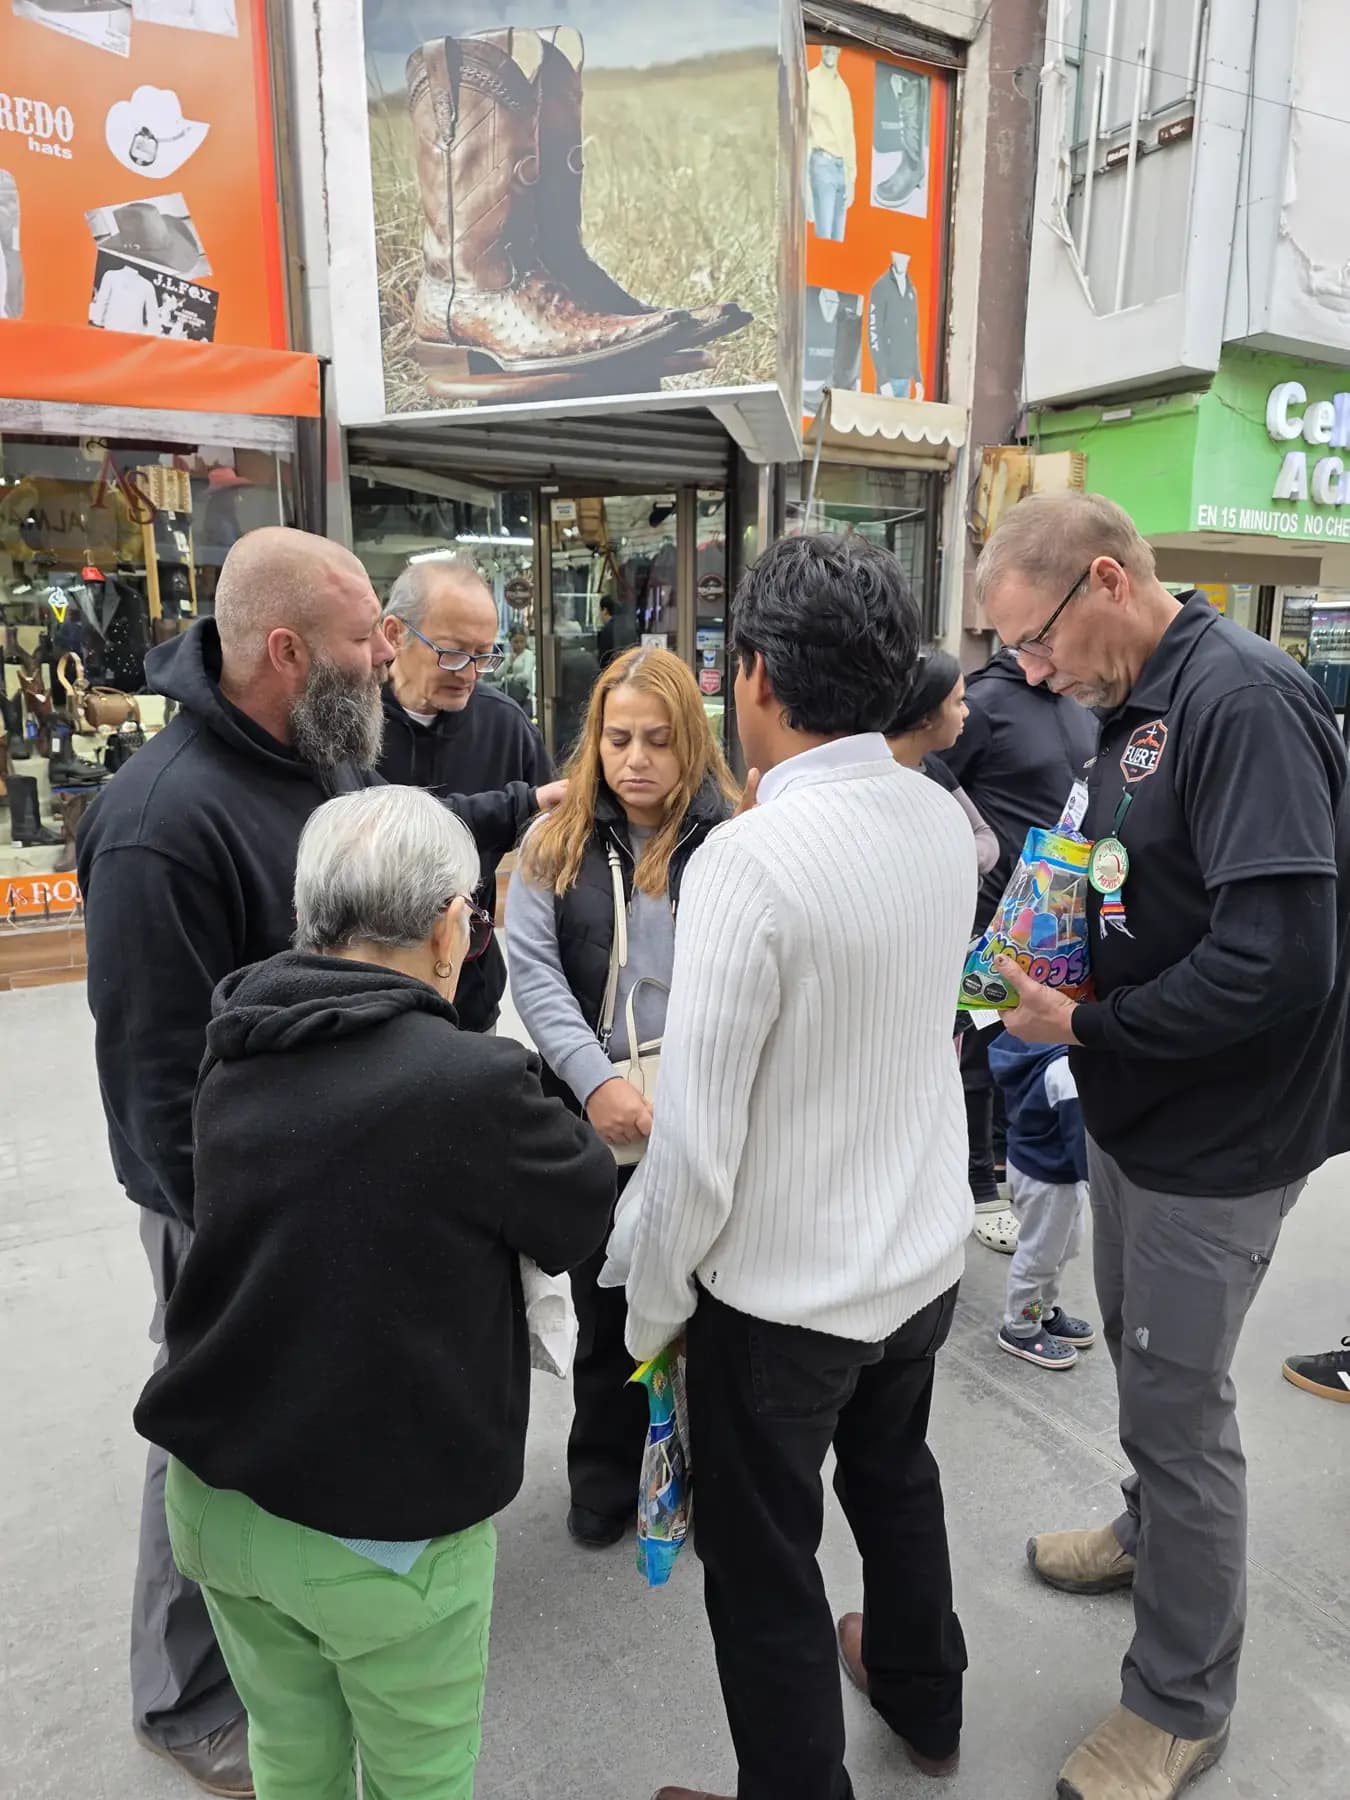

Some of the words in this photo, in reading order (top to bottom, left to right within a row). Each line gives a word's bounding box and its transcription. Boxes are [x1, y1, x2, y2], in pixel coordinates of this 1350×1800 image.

[28, 136, 72, 159] hats
[1197, 504, 1217, 526] EN
[1221, 507, 1237, 528] 15
[1239, 509, 1298, 533] MINUTOS
[1304, 514, 1323, 535] NO
